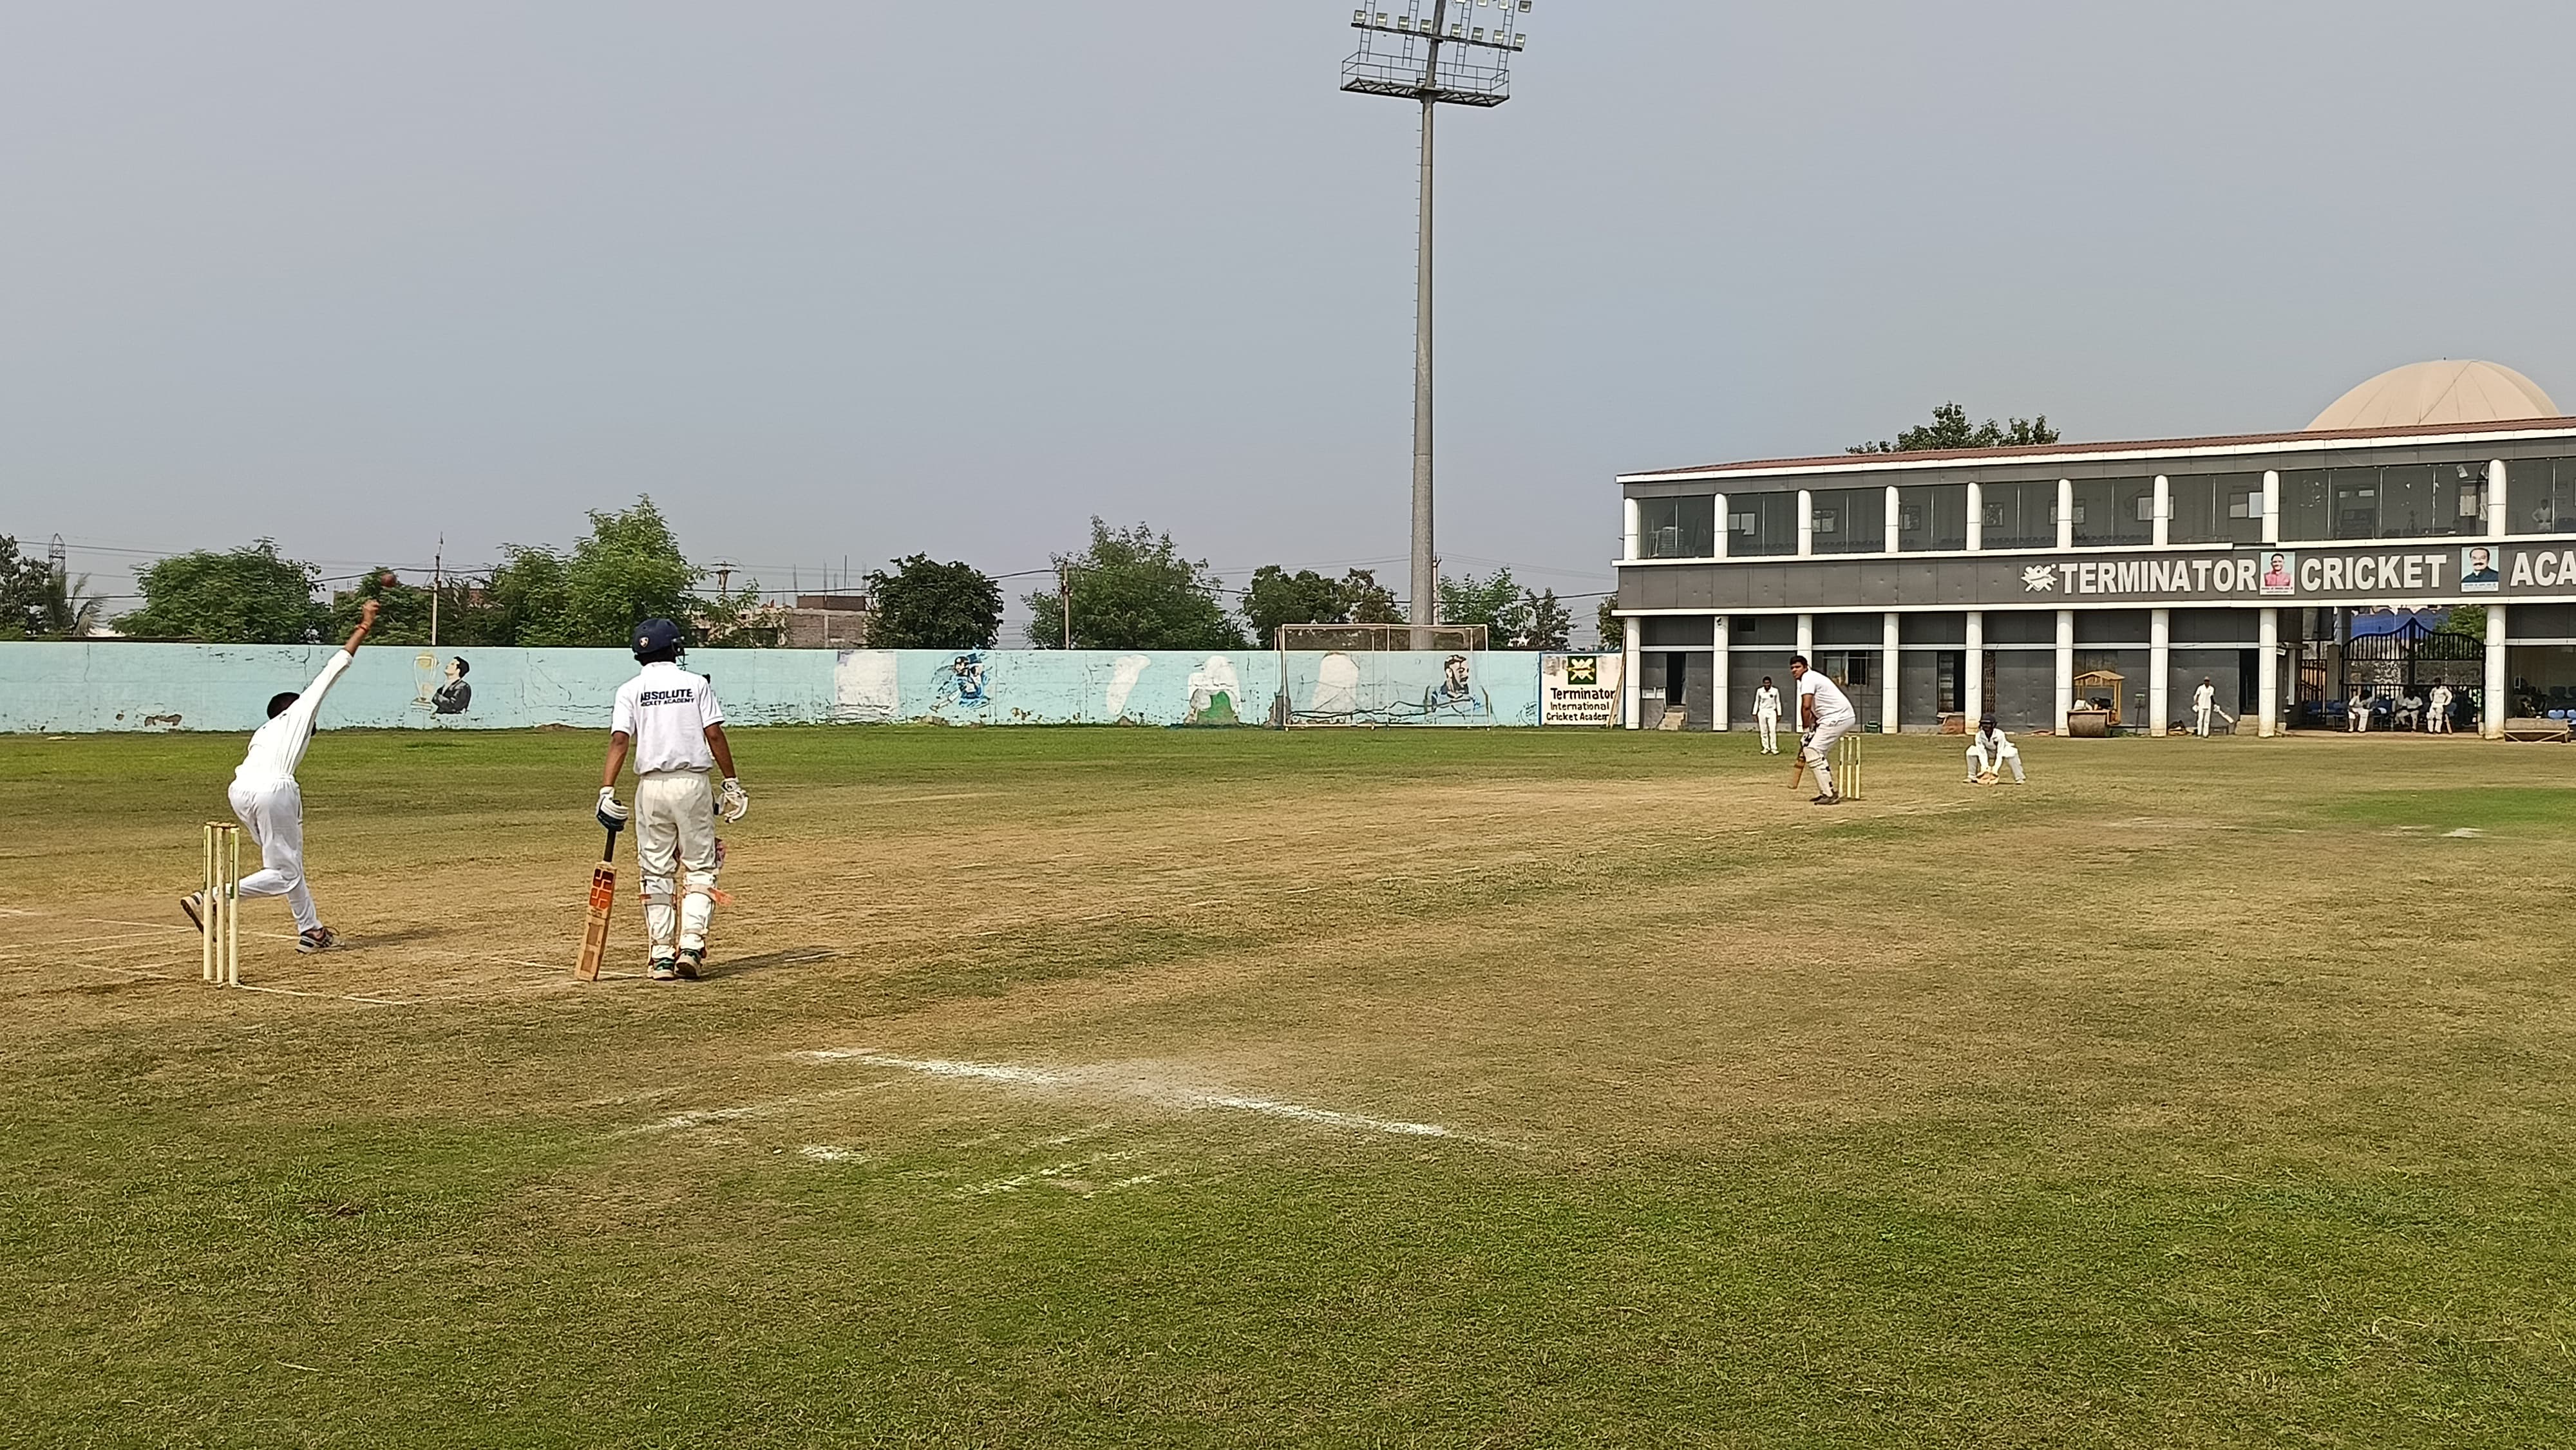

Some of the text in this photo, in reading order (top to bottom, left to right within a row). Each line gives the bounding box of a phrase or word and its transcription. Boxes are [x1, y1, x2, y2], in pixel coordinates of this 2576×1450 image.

[2059, 559, 2257, 594] TERMINATOR
[2300, 554, 2447, 591] CRICKET
[640, 688, 693, 702] ABSOLUTE
[1550, 688, 1616, 700] Terminator
[1550, 701, 1609, 711] International
[1546, 712, 1578, 720] Cricket
